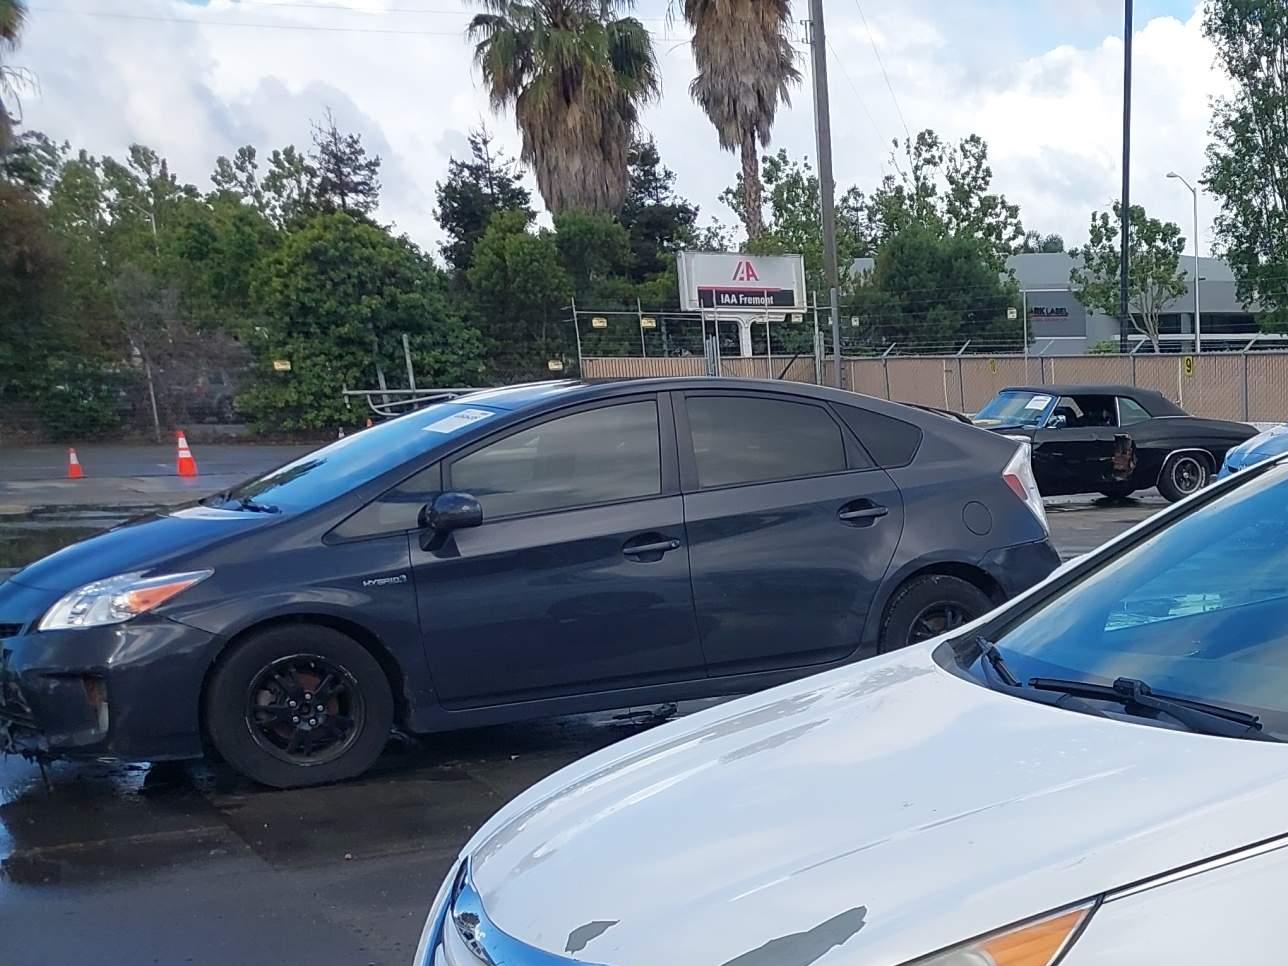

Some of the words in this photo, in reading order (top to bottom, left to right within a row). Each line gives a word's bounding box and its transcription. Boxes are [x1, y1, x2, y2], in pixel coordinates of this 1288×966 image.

[720, 294, 737, 305] IAA
[739, 294, 774, 306] Fremont
[1185, 358, 1193, 374] 9
